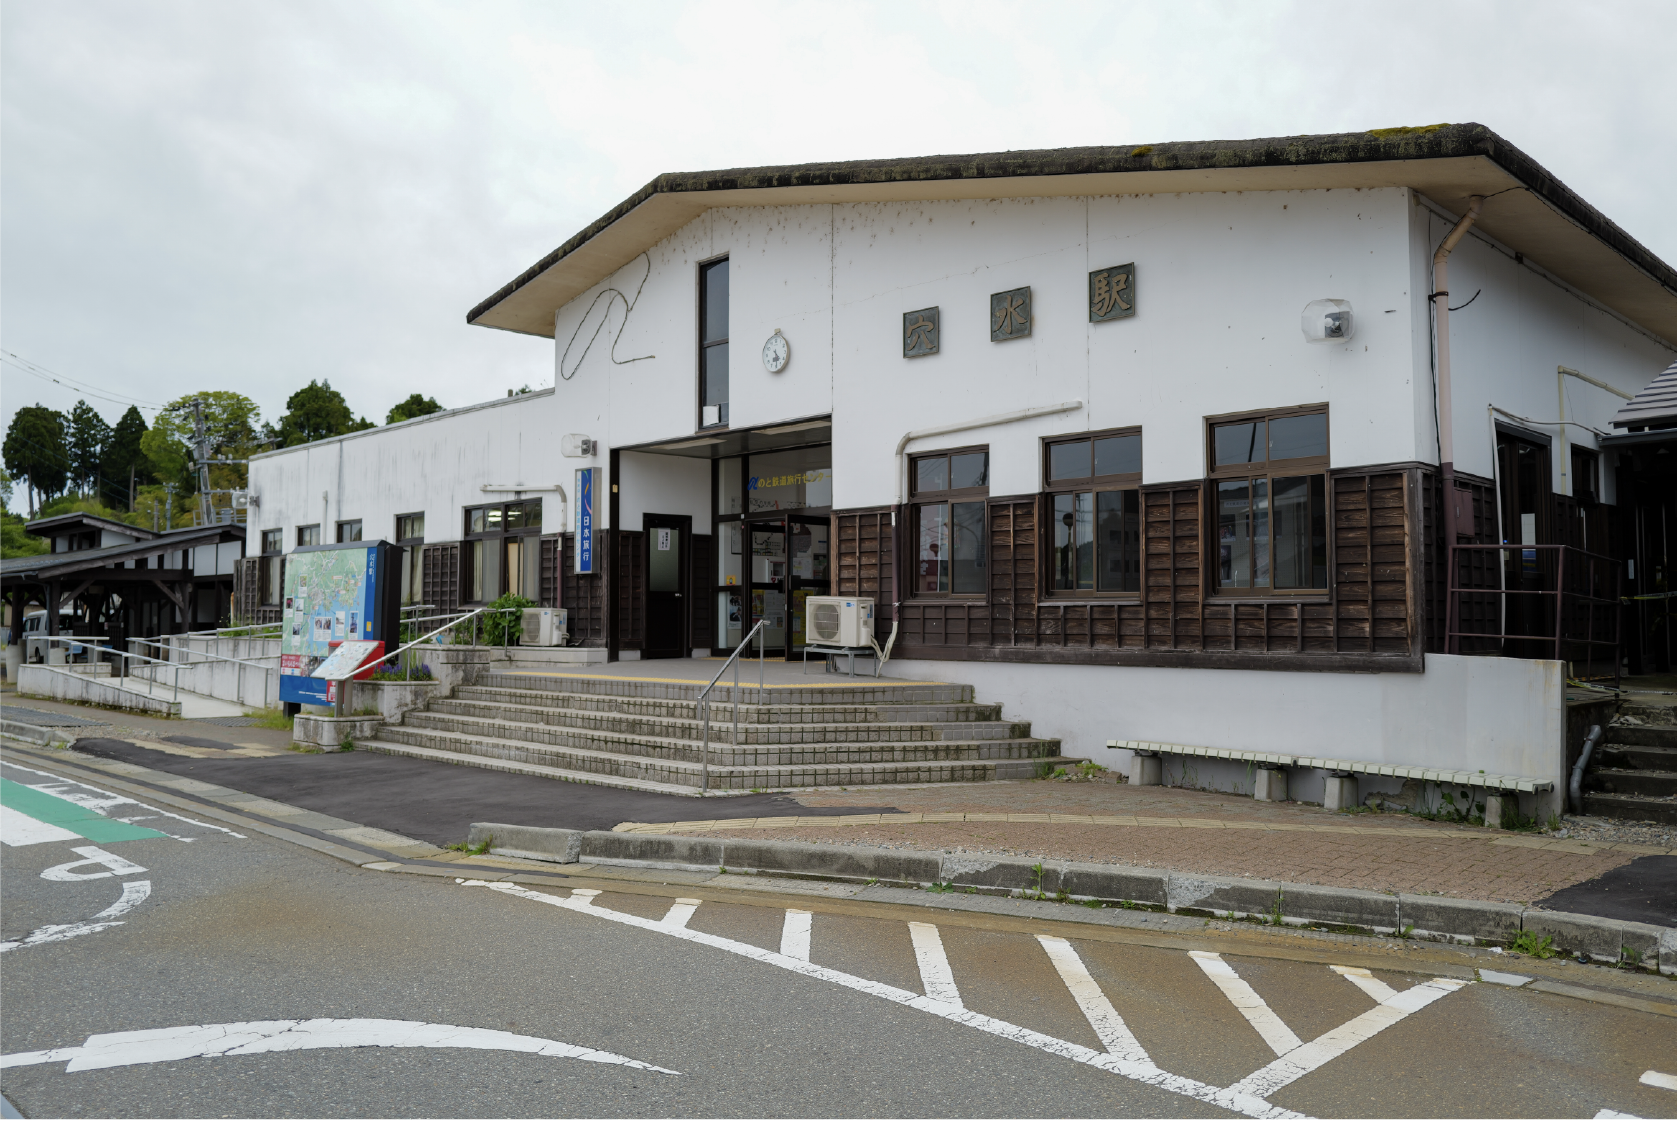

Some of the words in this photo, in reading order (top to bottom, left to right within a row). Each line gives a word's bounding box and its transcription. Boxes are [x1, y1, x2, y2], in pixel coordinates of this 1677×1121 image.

[906, 272, 1131, 352] 穴水駅
[758, 472, 832, 488] のと鉄道旅行センター
